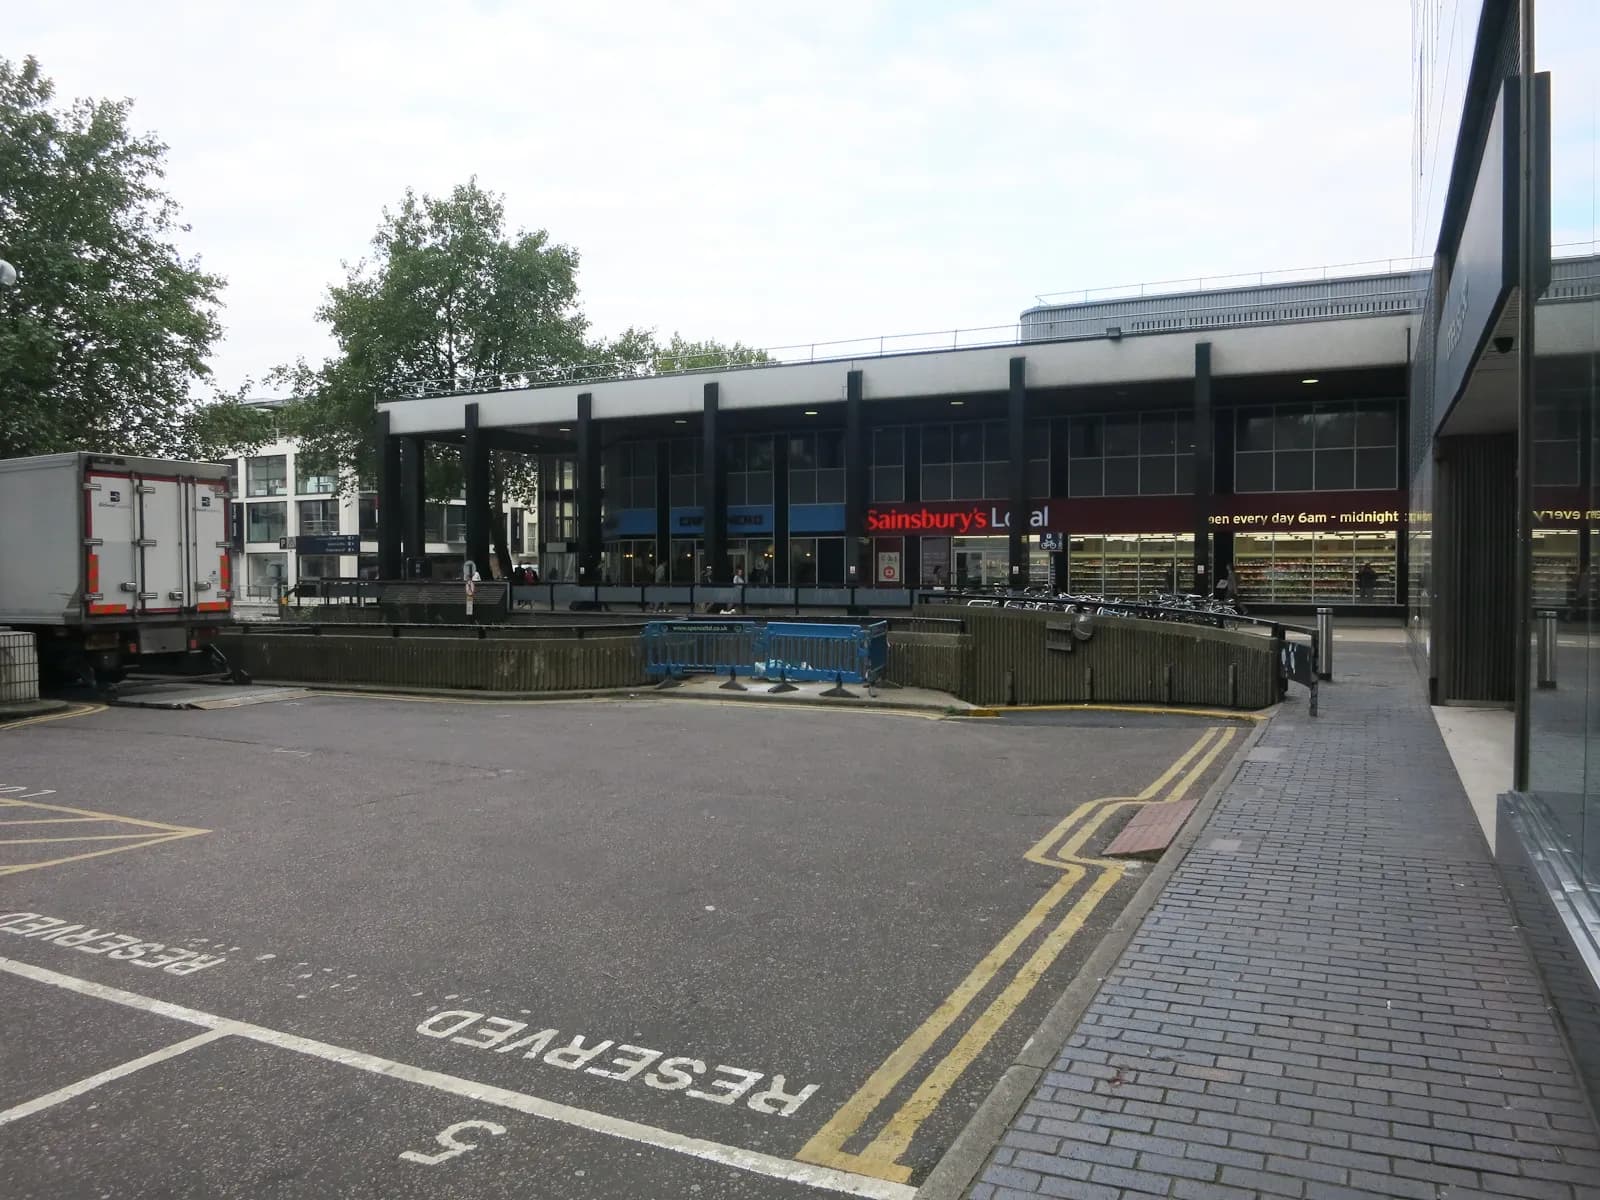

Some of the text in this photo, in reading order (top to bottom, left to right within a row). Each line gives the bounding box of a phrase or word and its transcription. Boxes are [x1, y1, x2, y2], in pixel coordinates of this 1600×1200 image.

[867, 506, 1049, 533] Sainsbury's Lal
[1233, 513, 1268, 526] every
[1271, 511, 1295, 526] day
[1298, 512, 1327, 523] 6am
[1340, 510, 1399, 525] midnight
[415, 1009, 820, 1117] RESERVED
[398, 1120, 507, 1166] 5
